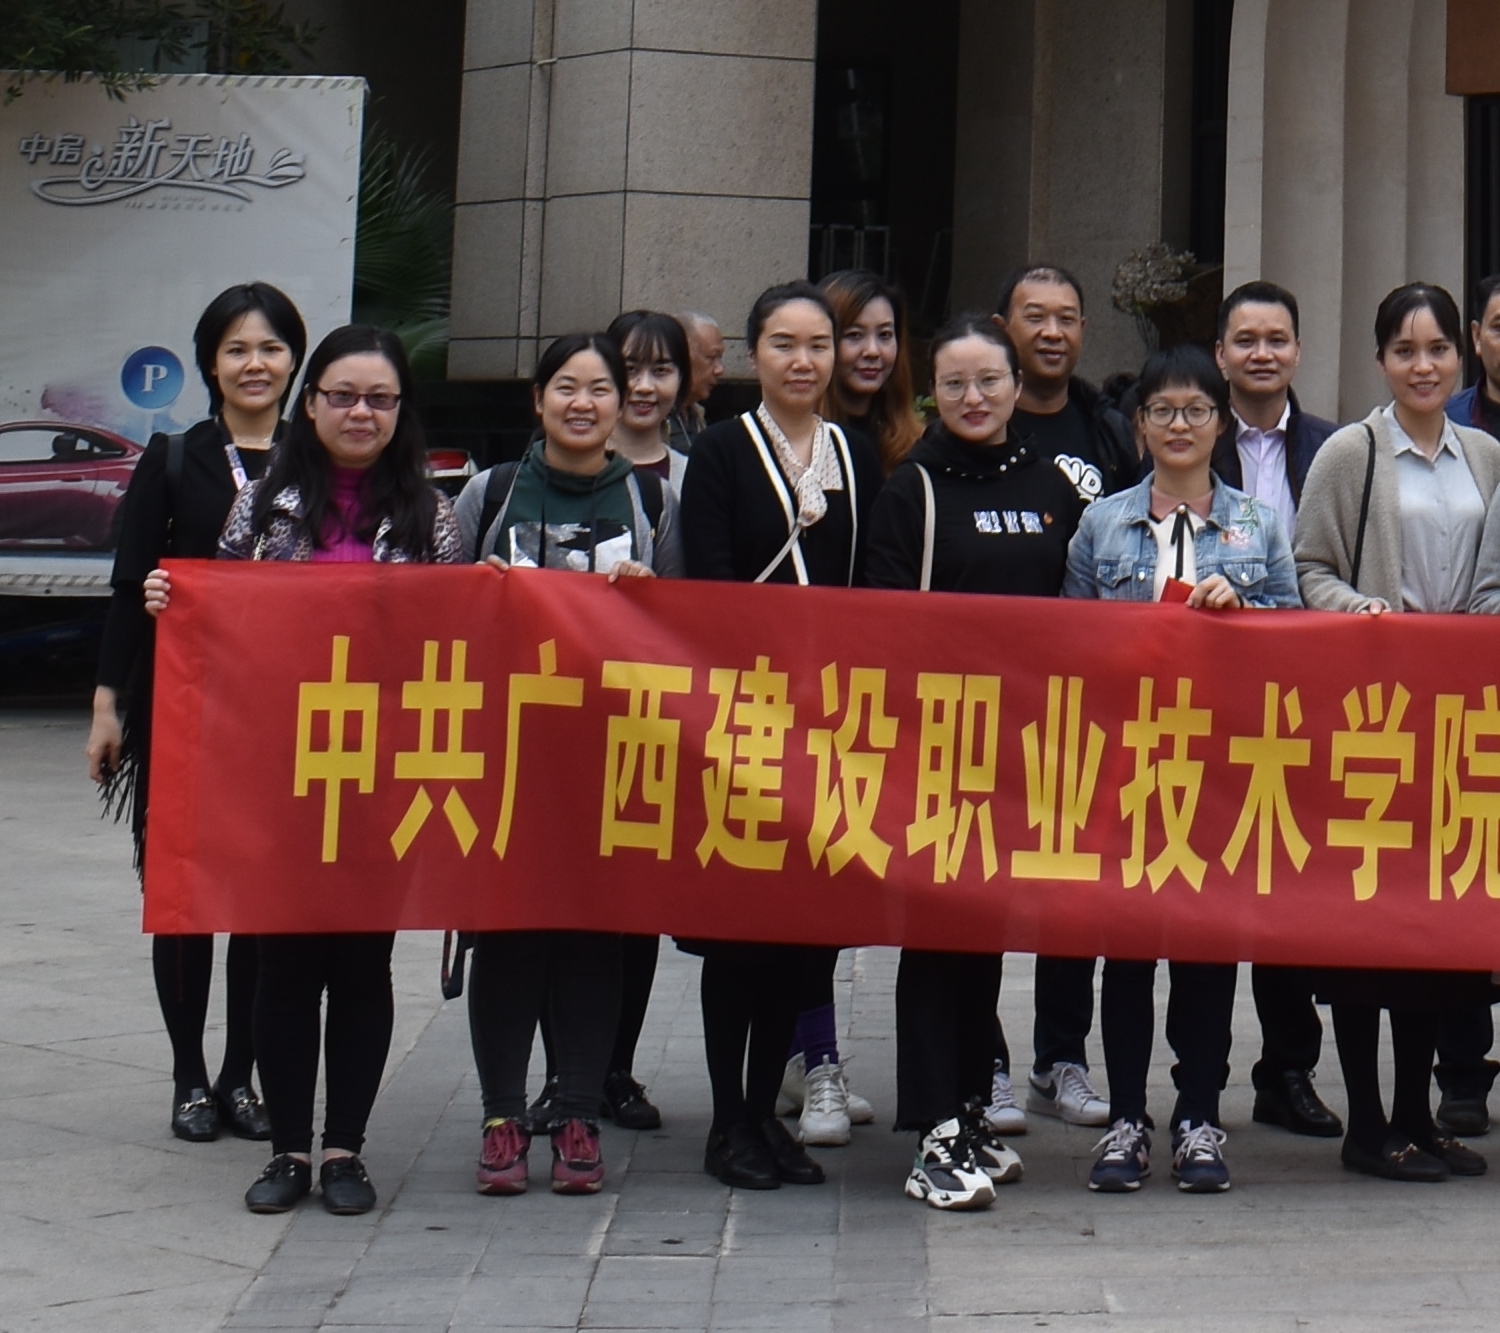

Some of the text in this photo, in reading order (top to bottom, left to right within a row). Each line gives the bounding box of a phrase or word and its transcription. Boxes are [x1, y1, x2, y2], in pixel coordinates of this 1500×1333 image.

[19, 117, 256, 186] 中房新天地
